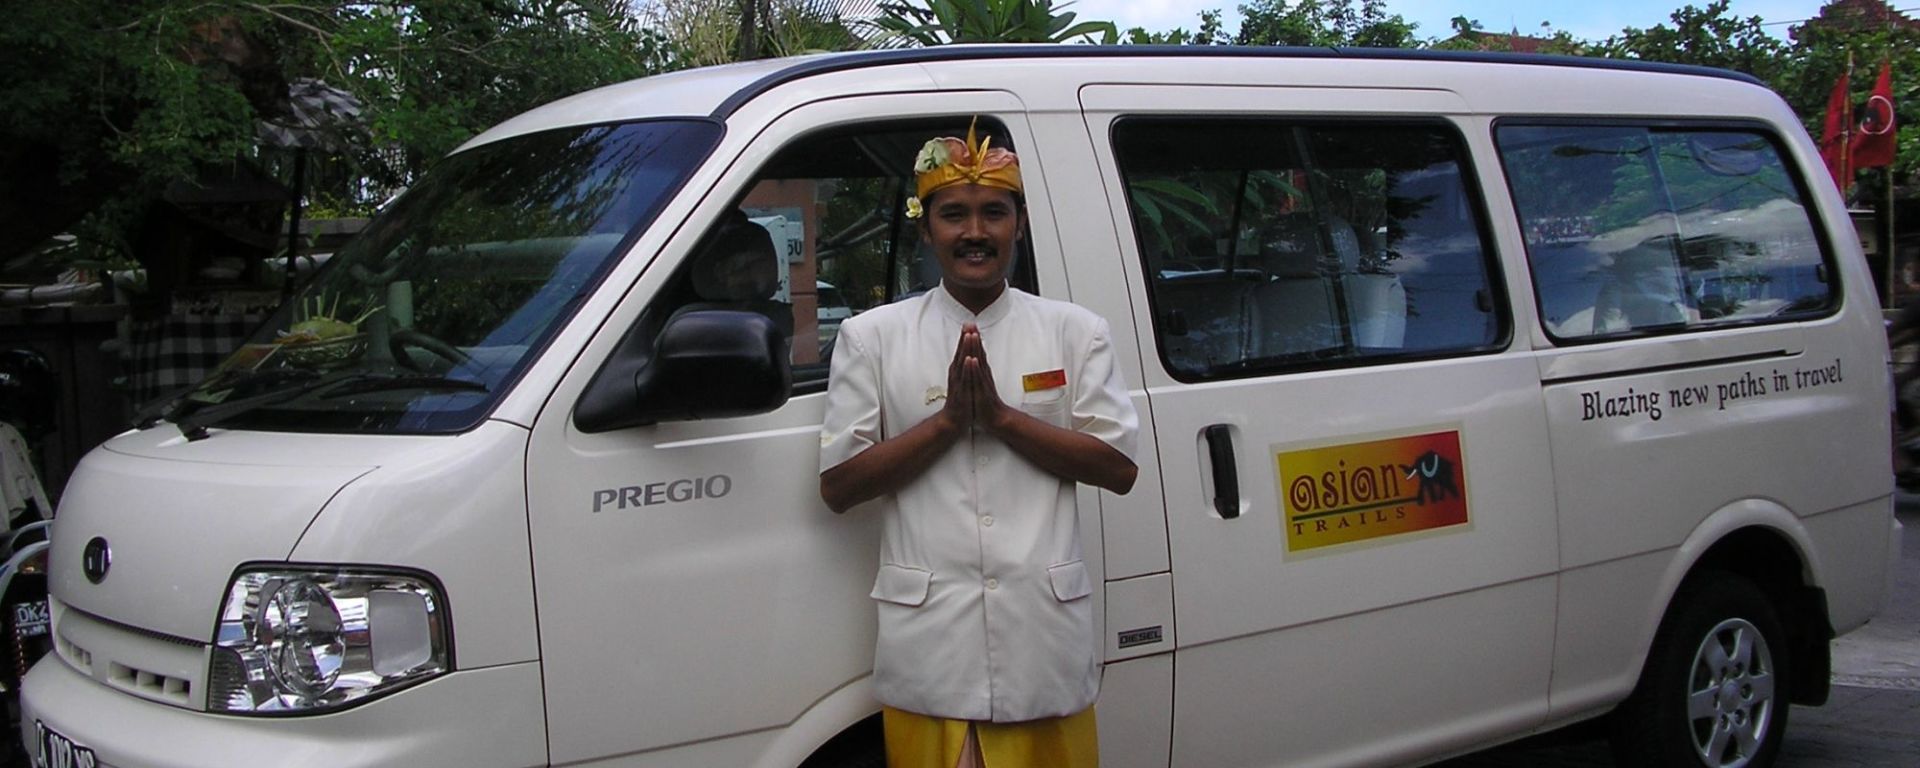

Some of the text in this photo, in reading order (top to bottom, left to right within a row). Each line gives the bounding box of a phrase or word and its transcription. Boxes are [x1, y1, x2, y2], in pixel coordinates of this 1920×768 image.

[1581, 358, 1843, 421] Blazing new paths in travel
[592, 474, 732, 513] PREGIO
[1289, 459, 1401, 513] asian
[1293, 506, 1406, 536] TRAILS
[1119, 629, 1163, 645] DIESEL
